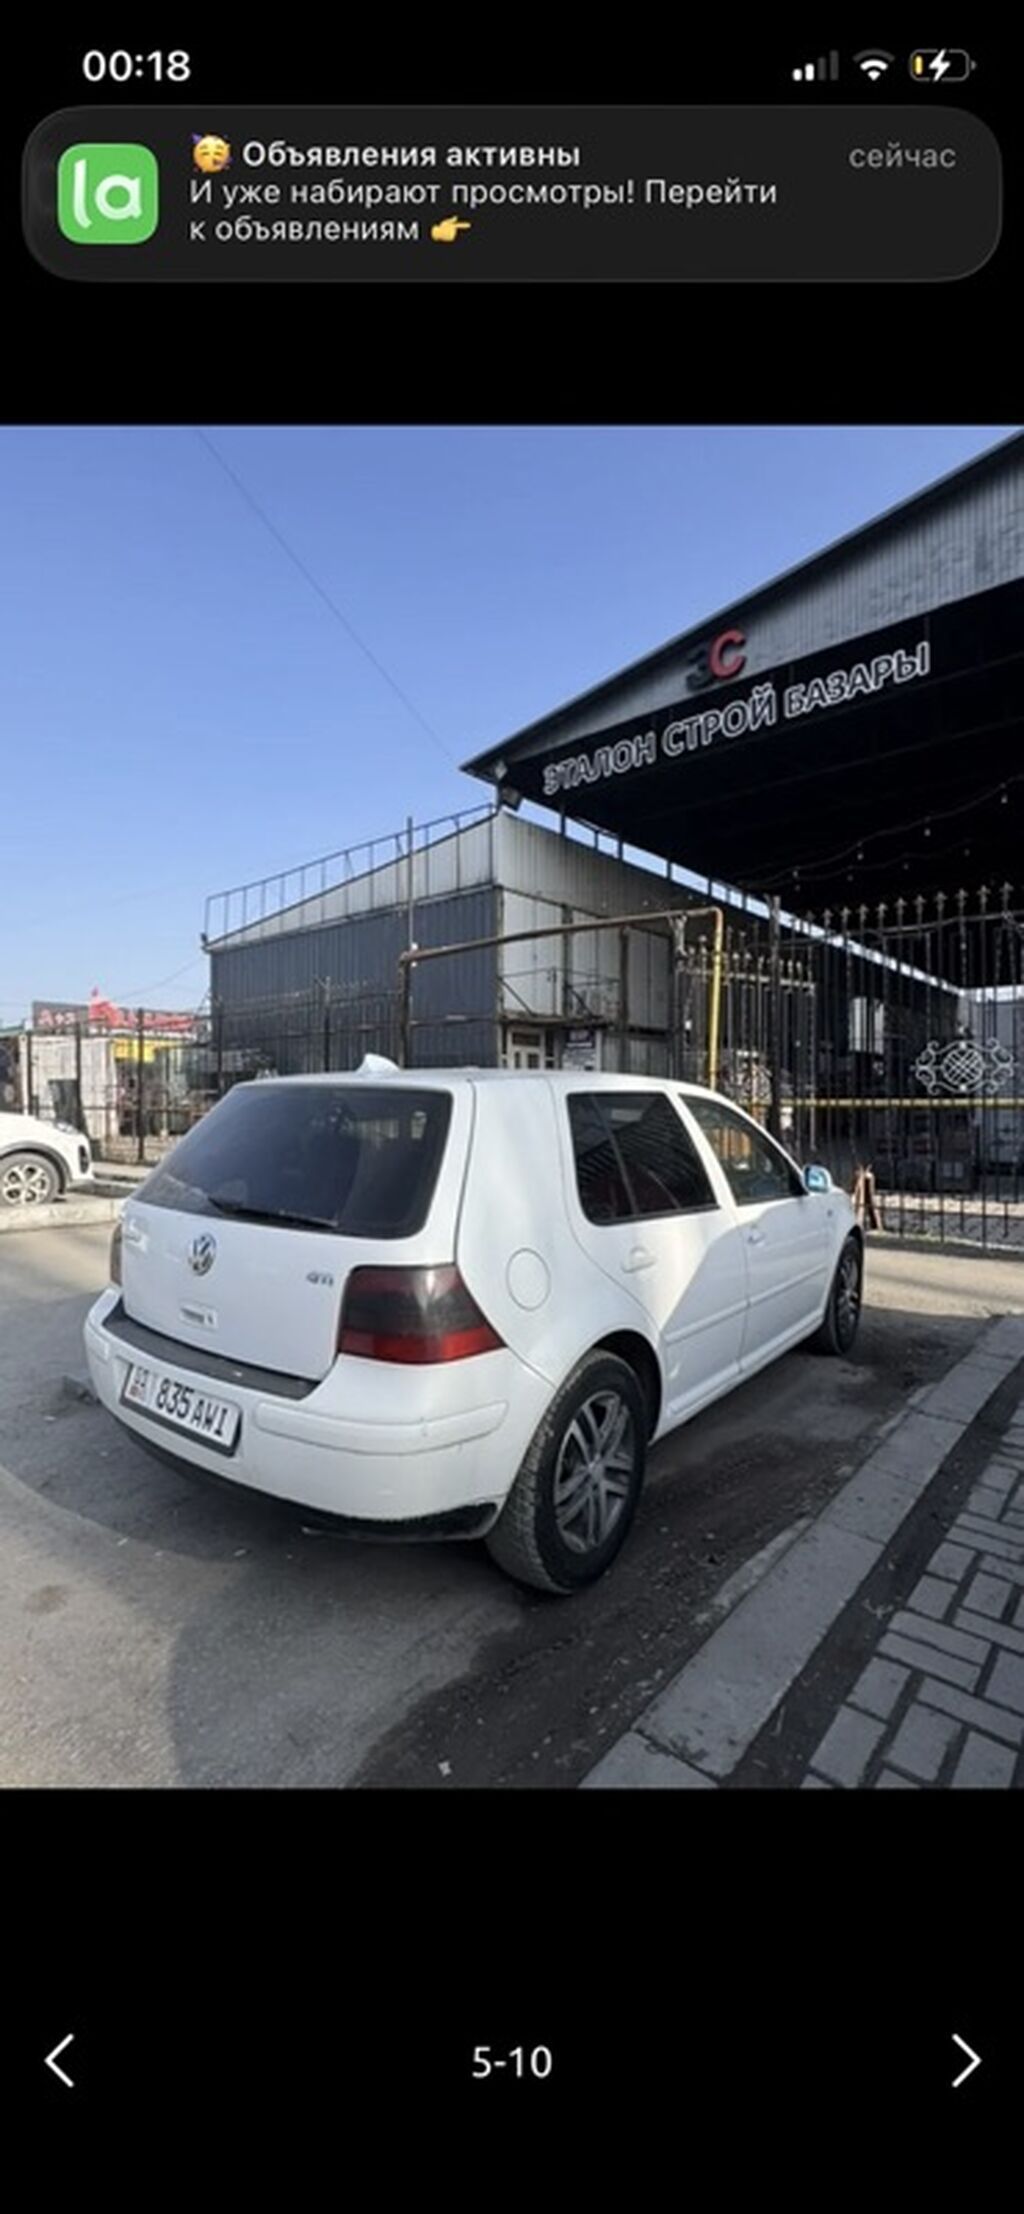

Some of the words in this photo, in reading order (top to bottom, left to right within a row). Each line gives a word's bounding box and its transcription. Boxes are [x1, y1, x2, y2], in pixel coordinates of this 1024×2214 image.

[542, 731, 657, 795] ЭТАЛОН
[662, 682, 777, 757] СТРОЙ
[784, 641, 931, 718] БАЗАРЫ
